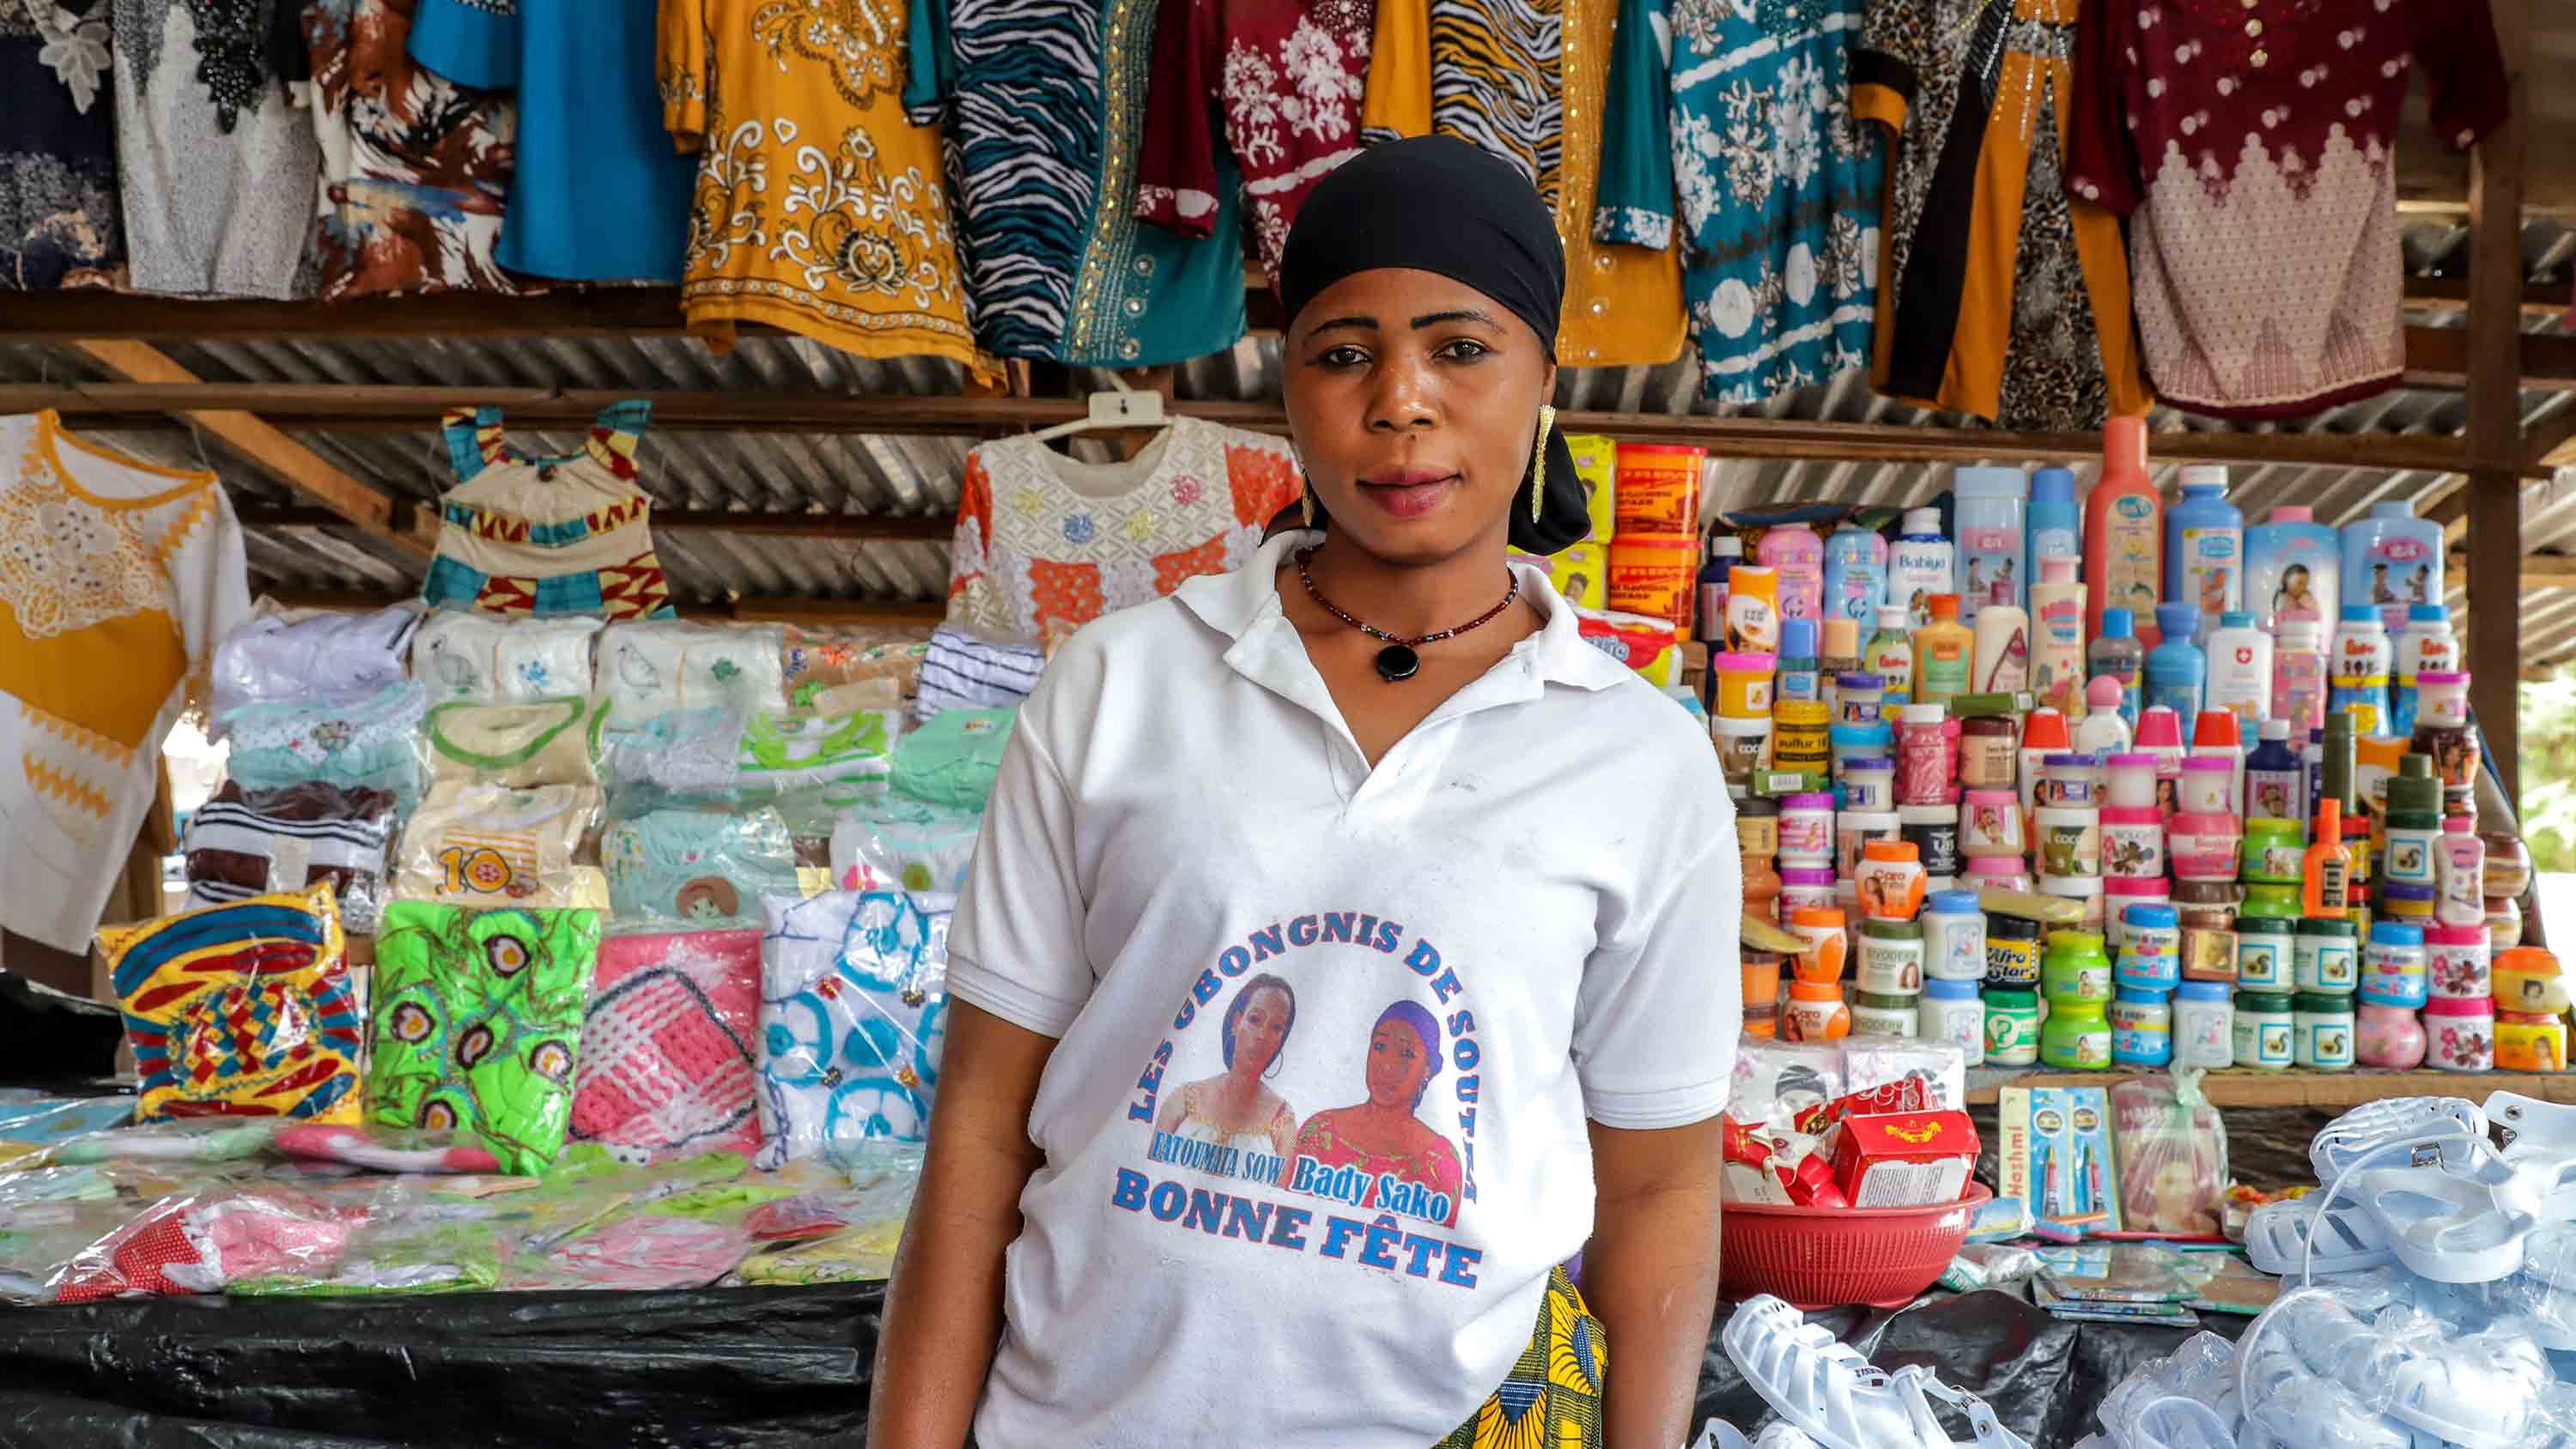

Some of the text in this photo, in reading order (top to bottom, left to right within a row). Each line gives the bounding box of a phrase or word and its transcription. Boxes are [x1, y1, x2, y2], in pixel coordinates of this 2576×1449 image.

[1128, 1037, 1174, 1125] LES
[1174, 912, 1404, 1031] GBONGNIS
[1404, 938, 1463, 1004] DE
[1242, 1151, 1285, 1185] SOW
[1291, 1155, 1450, 1224] Bady Sako
[2007, 1125, 2024, 1196] Hashmi
[1112, 1167, 1483, 1288] BONNE FÊTE
